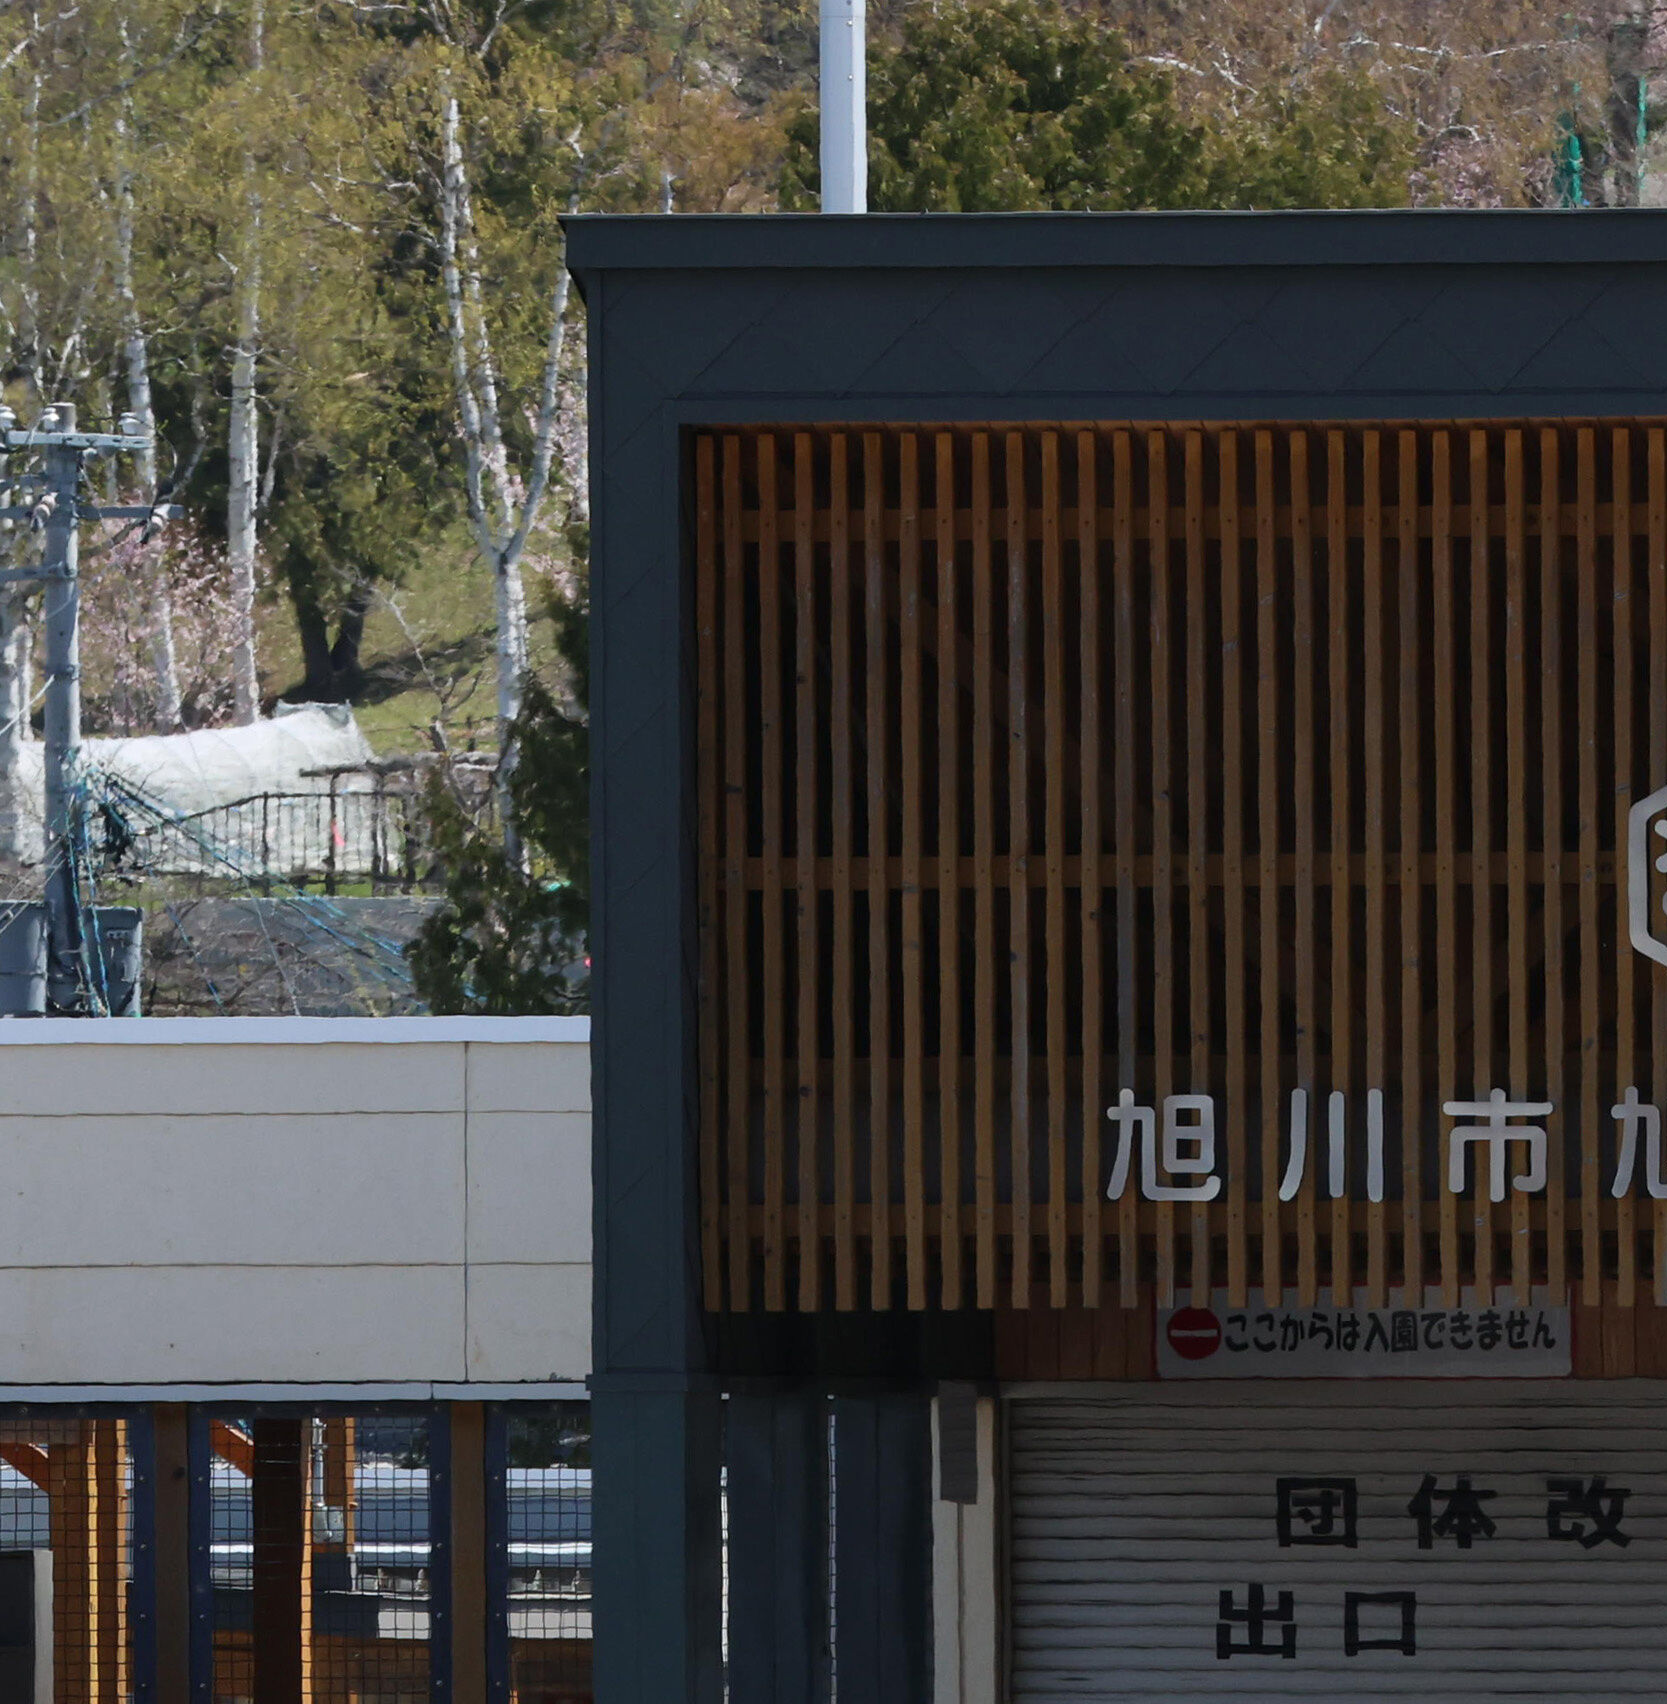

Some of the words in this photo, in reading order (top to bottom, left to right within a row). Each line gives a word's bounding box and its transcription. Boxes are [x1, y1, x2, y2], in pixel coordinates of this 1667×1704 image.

[1224, 1310, 1556, 1353] ここからは入園できません
[1216, 1583, 1417, 1660] 出口
